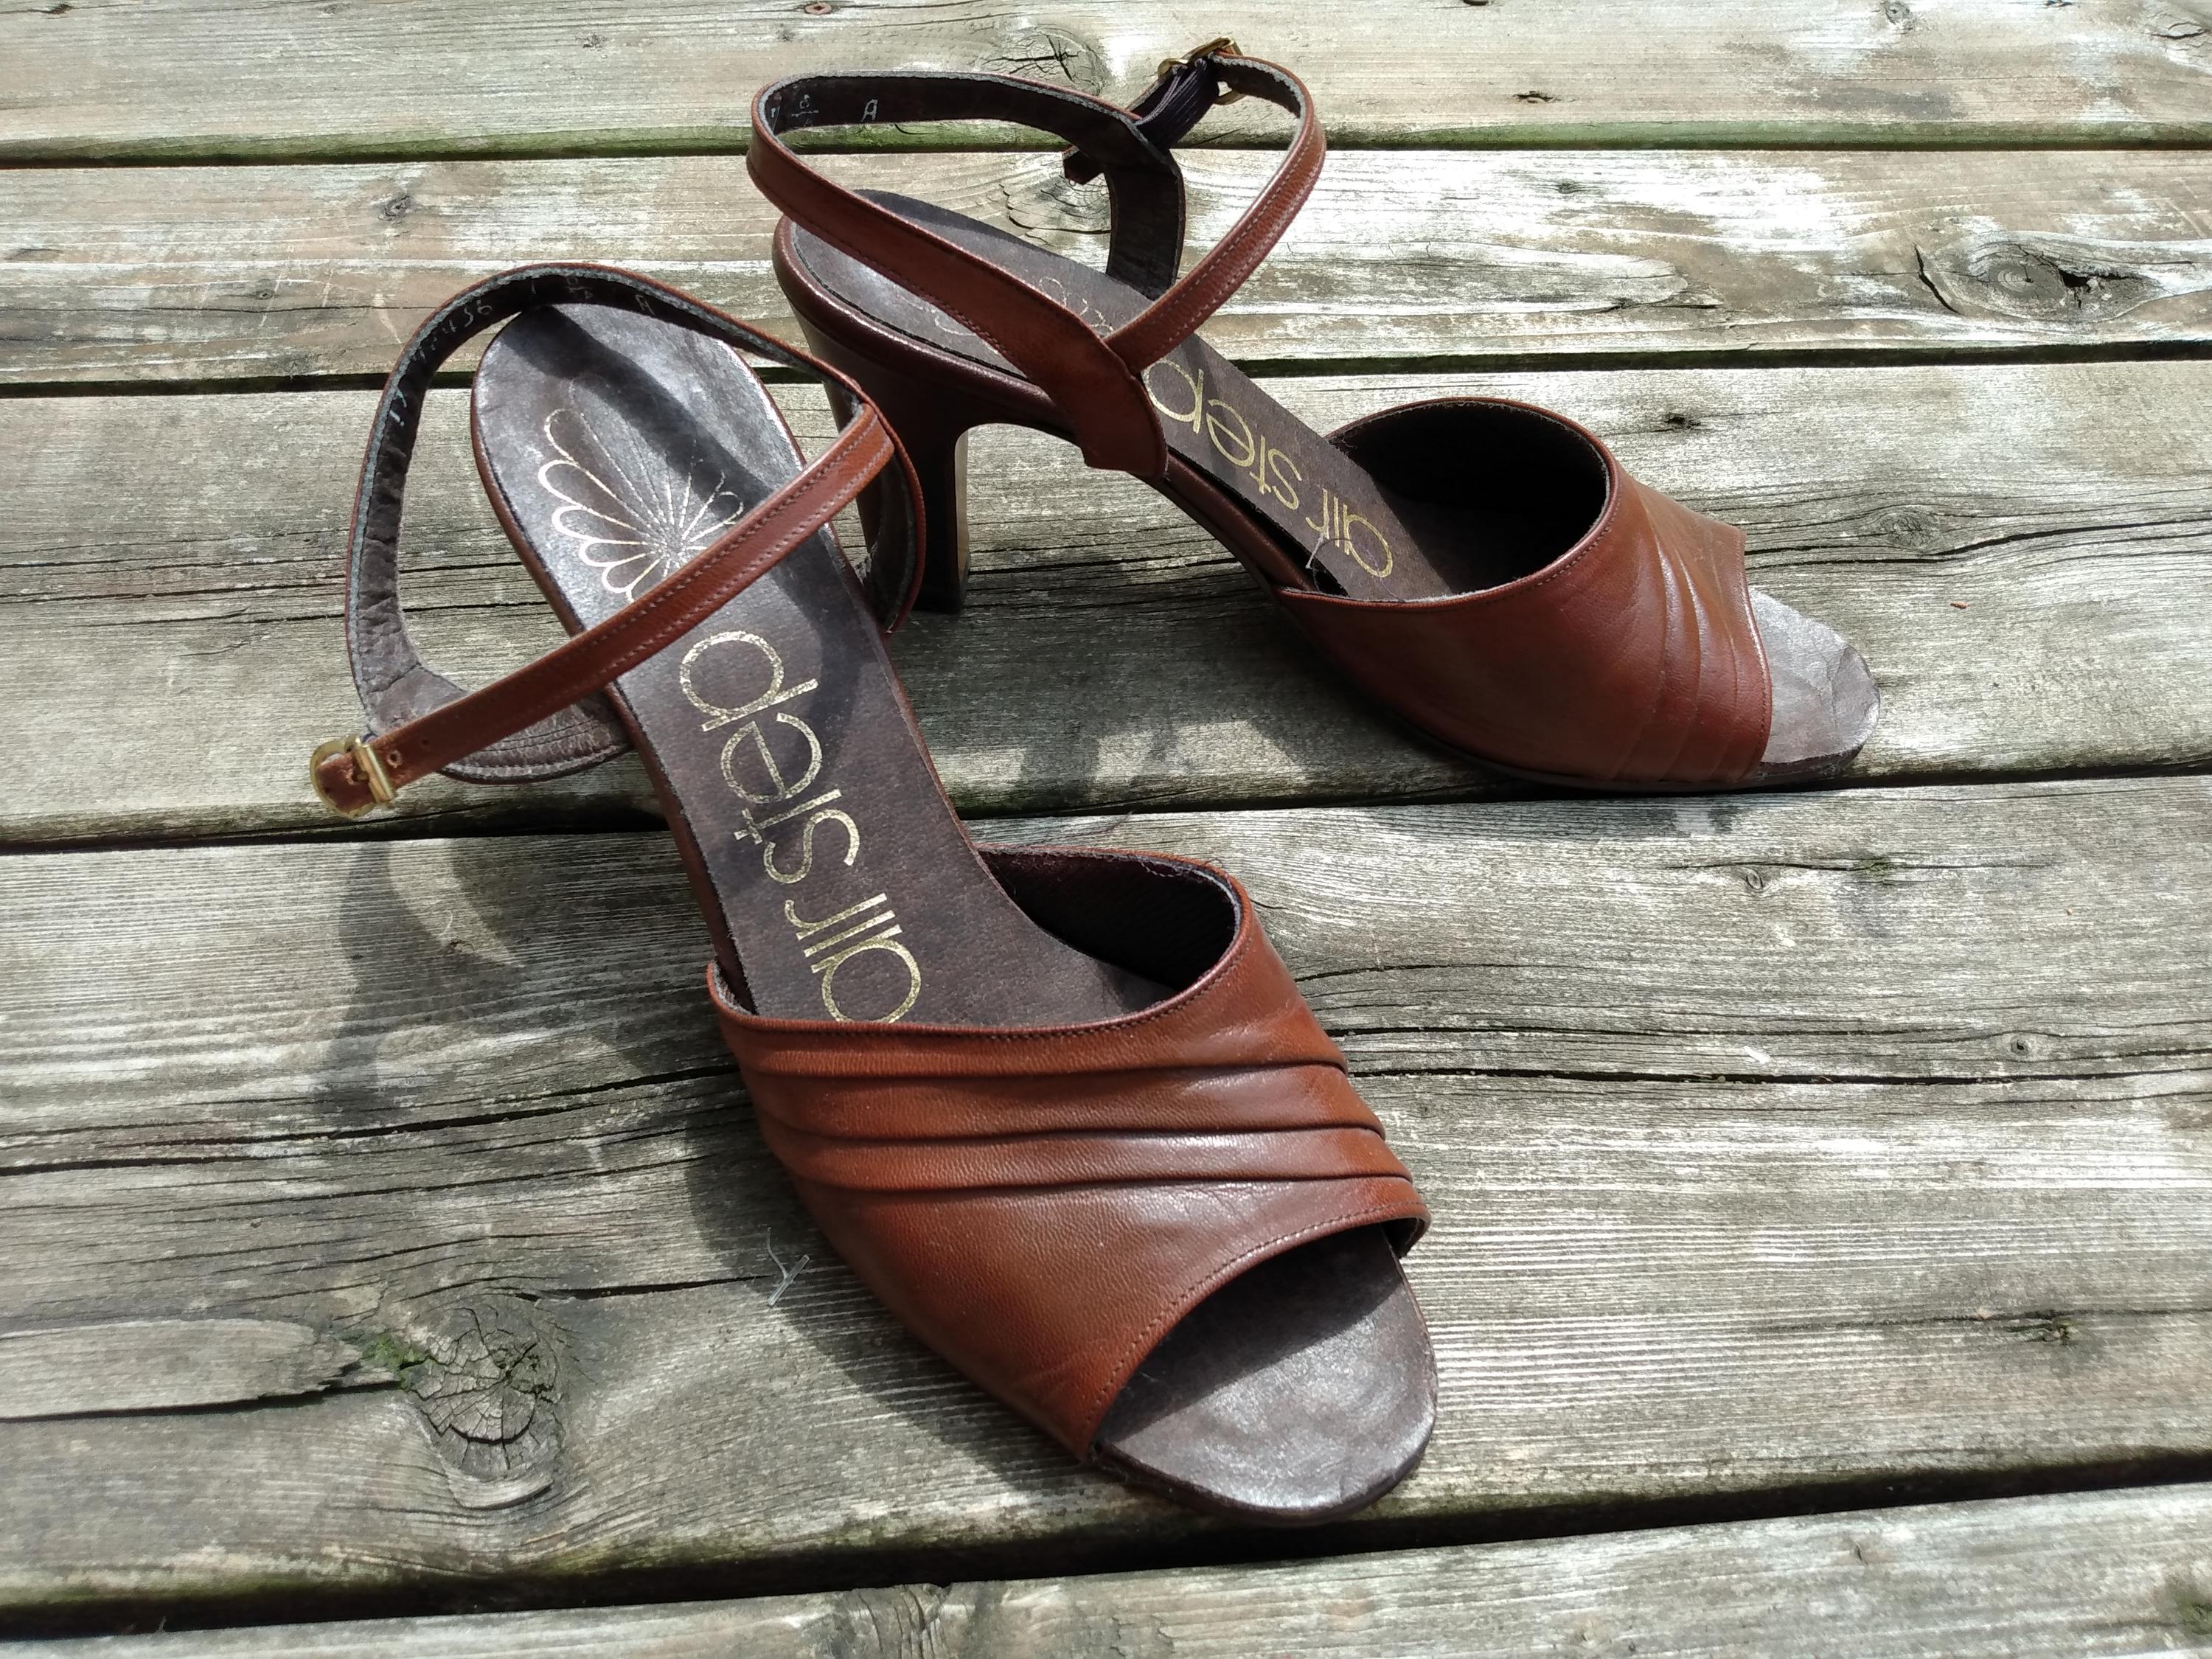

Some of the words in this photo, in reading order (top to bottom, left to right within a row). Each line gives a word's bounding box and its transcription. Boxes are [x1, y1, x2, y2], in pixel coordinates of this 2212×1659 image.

[1141, 358, 1302, 511] step
[1305, 487, 1394, 579] air
[680, 630, 861, 884] step
[783, 893, 922, 1024] air
